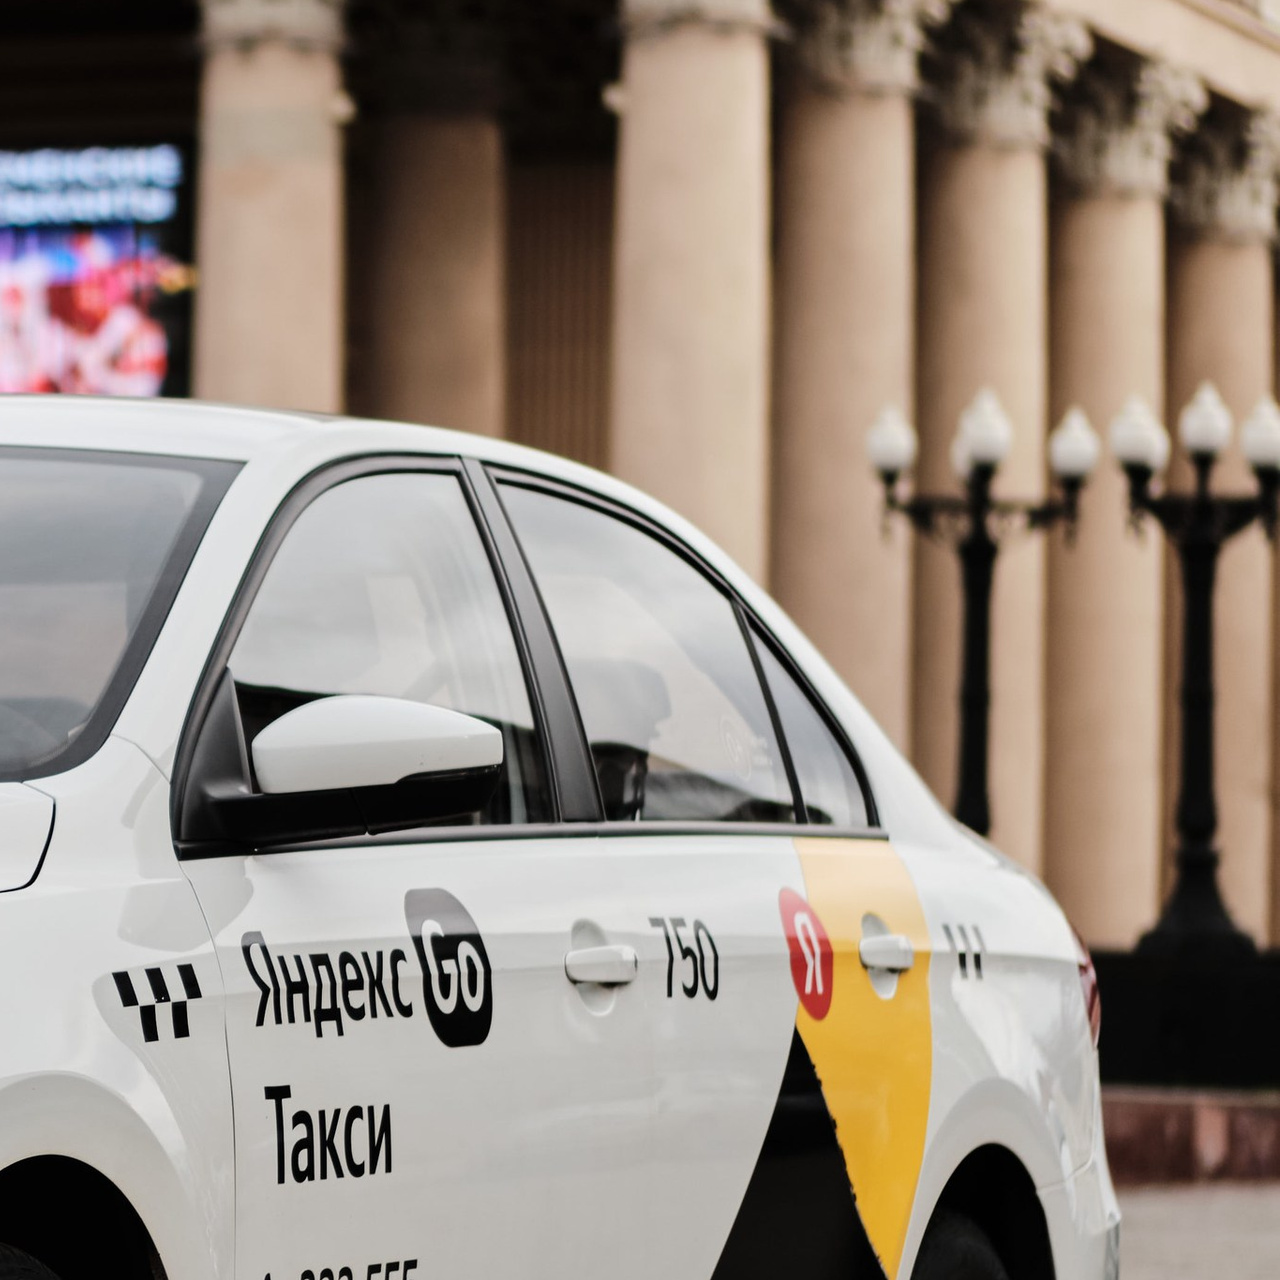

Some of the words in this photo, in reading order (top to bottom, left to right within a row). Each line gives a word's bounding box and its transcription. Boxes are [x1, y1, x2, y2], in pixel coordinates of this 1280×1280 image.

[241, 931, 413, 1038] Яндекс
[422, 919, 484, 1014] Go
[649, 917, 720, 1001] 750
[794, 912, 825, 995] Я
[264, 1084, 393, 1185] Такси
